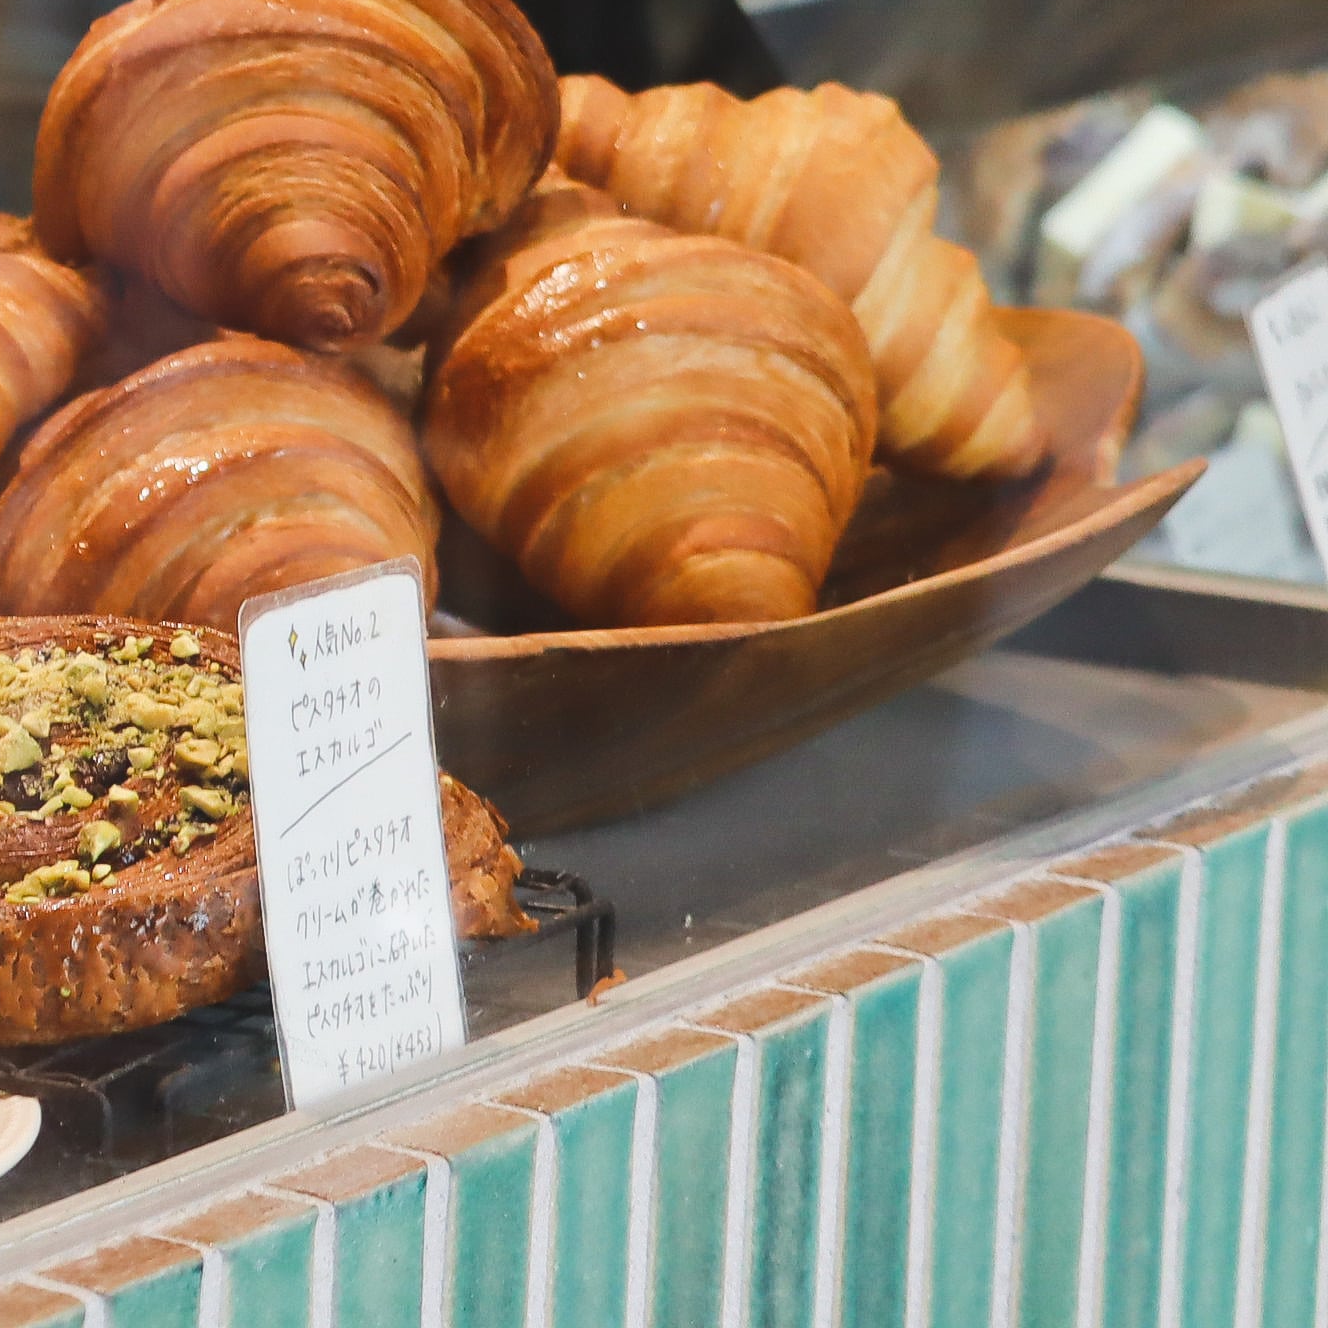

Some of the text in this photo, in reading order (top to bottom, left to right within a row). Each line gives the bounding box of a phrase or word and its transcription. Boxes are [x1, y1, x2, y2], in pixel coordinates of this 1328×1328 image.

[290, 673, 382, 733] ピスタチオの
[295, 716, 385, 777] エスカルゴ
